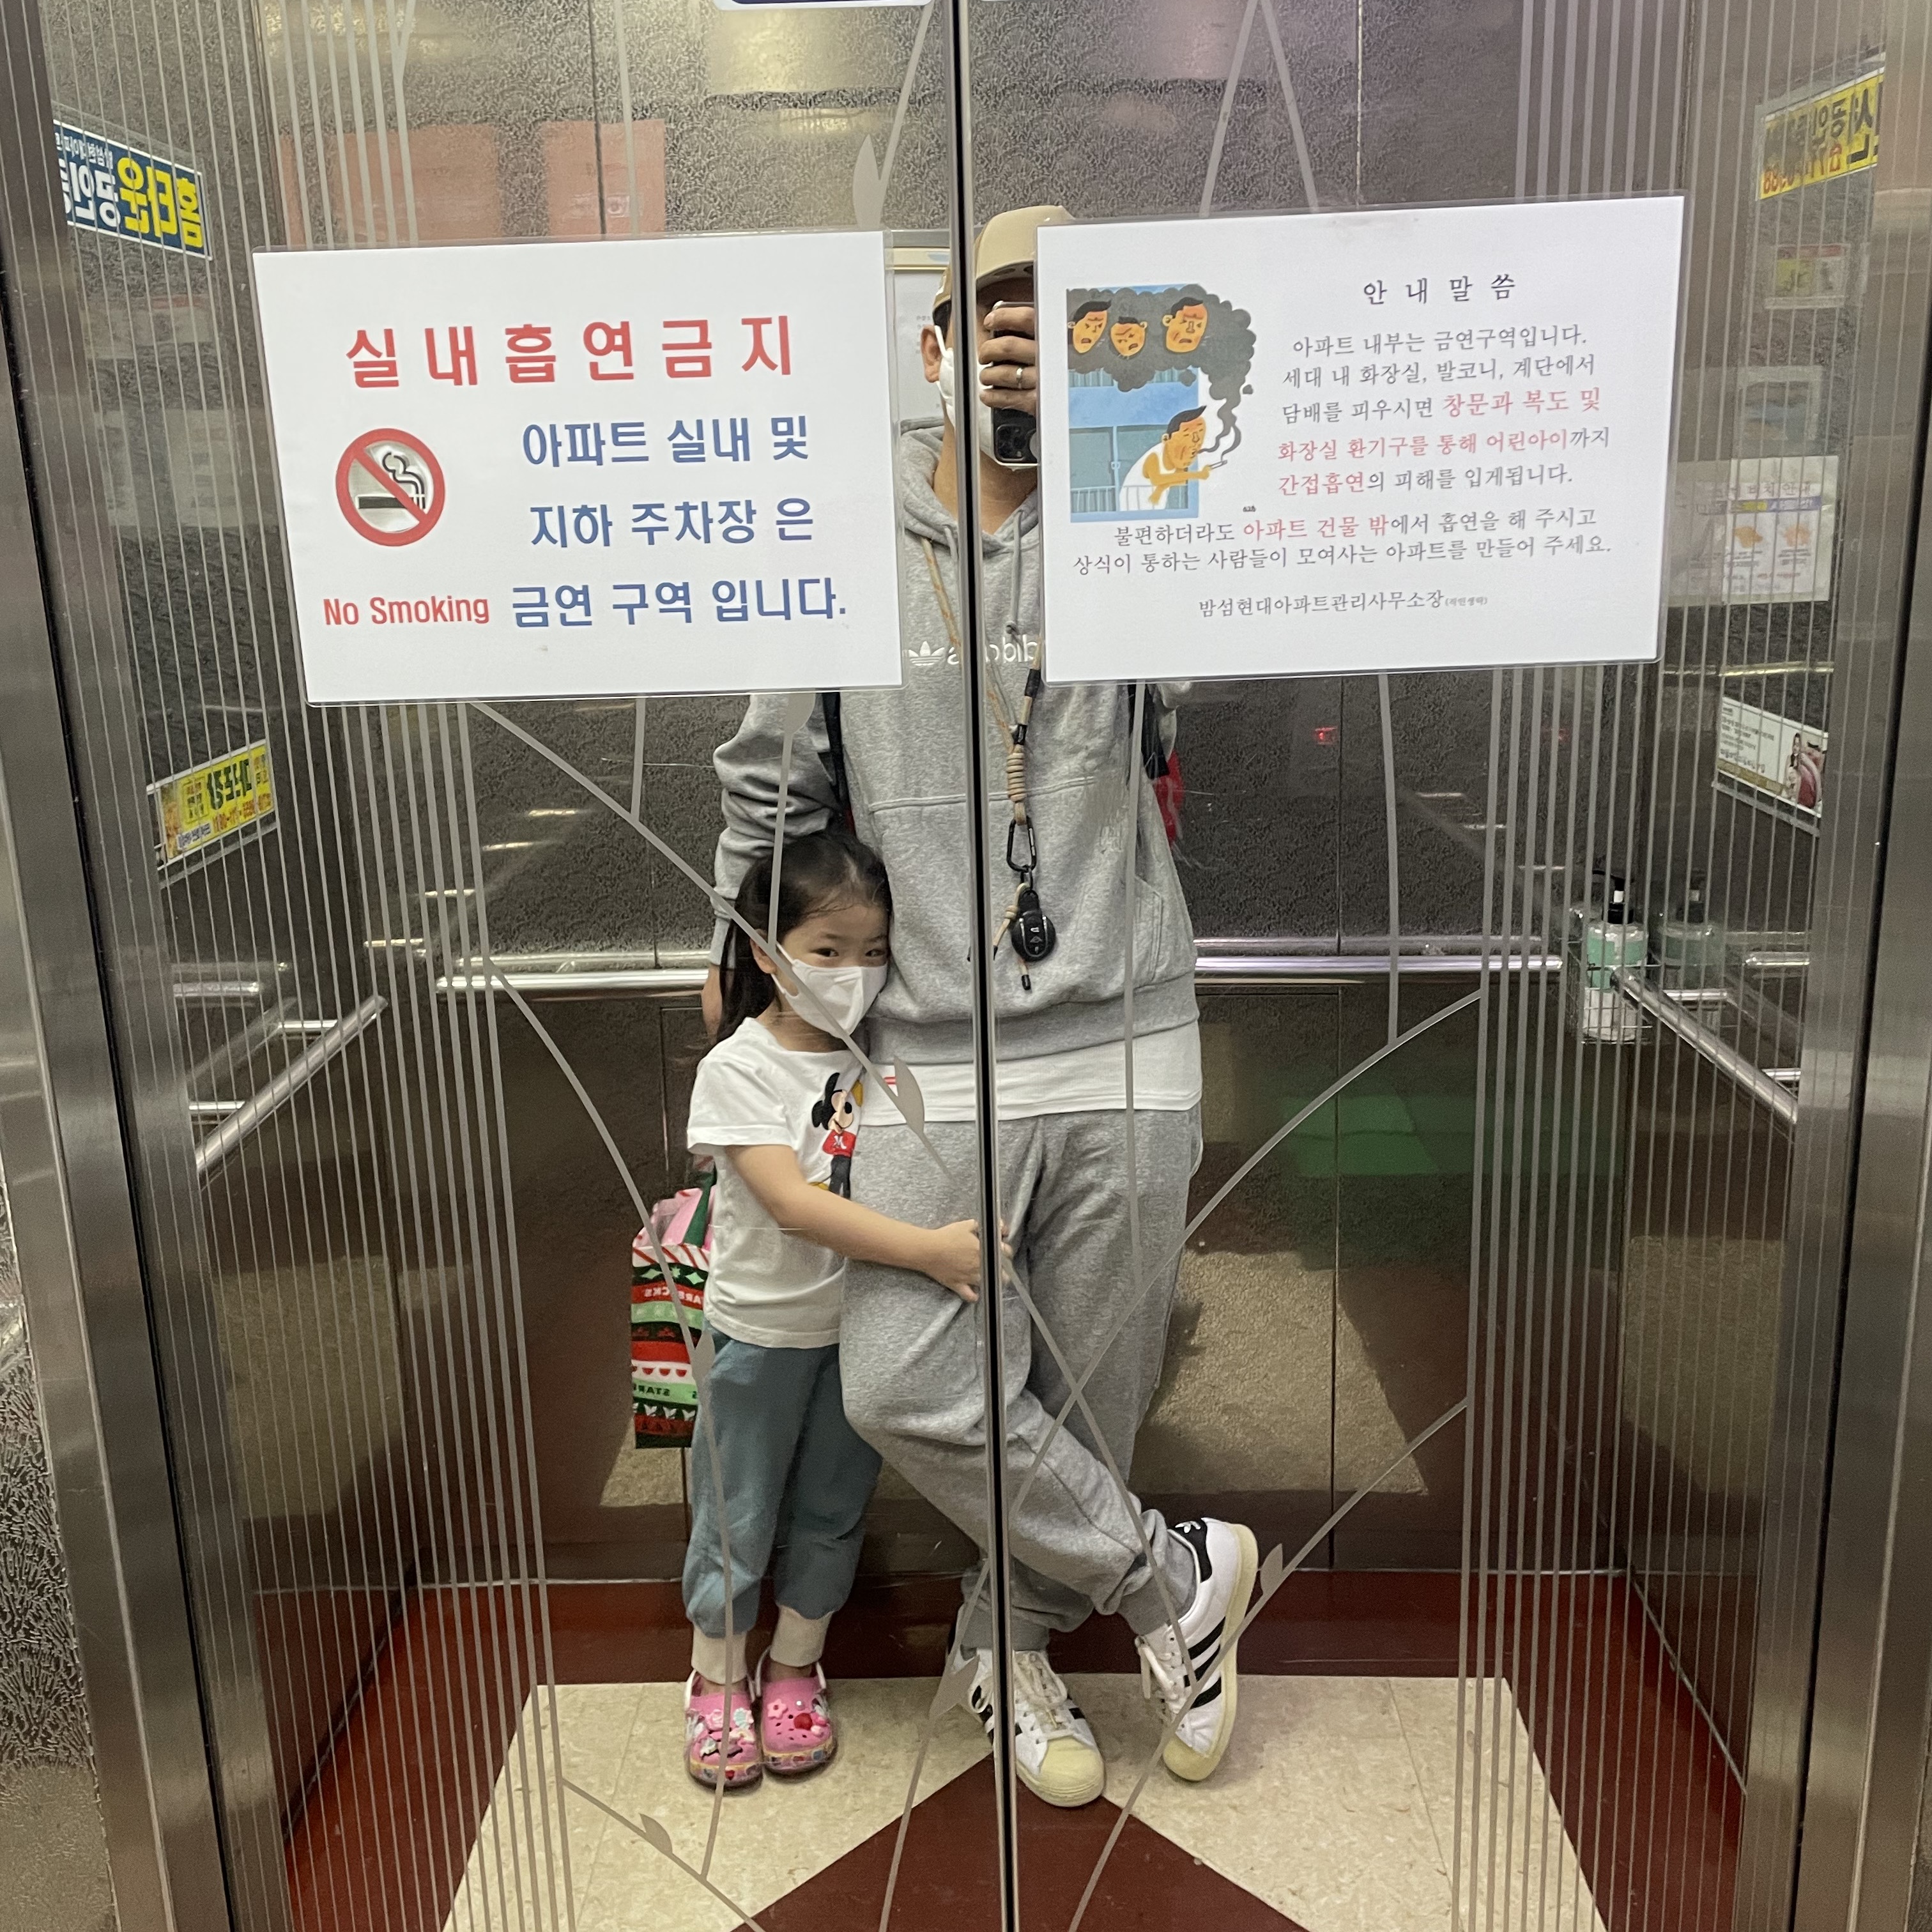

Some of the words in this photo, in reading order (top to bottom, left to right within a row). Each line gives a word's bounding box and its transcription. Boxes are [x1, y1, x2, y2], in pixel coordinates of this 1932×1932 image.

[1293, 336, 1354, 358] 아파트
[1363, 333, 1425, 355] 내부는
[1434, 324, 1586, 351] 금연구역입니다.
[1284, 367, 1321, 388] 세대
[1332, 365, 1349, 386] 내
[1360, 362, 1427, 385] 화장실,
[1437, 358, 1503, 381] 발코니,
[1514, 354, 1593, 378] 계단에서
[1283, 402, 1342, 424] 담배를
[1351, 397, 1432, 420] 피우시면
[1444, 392, 1513, 417] 창문과
[1523, 390, 1568, 413] 복도
[1581, 387, 1599, 411] 및
[523, 422, 649, 468] 아파트
[667, 418, 750, 463] 실내
[771, 415, 808, 461] 및
[1278, 440, 1337, 461] 화장실
[1347, 436, 1428, 458] 환기구를
[1438, 433, 1476, 455] 통해
[1487, 427, 1609, 452] 어린아이까지
[1279, 471, 1384, 496] 간접흡연의
[1395, 469, 1456, 491] 피해를
[1465, 463, 1572, 488] 입게됩니다.
[530, 504, 613, 548] 지하
[631, 500, 756, 546] 주차장
[776, 498, 813, 540] 은
[1114, 523, 1234, 546] 불편하더라도
[1244, 519, 1307, 541] 아파트
[1317, 517, 1359, 538] 건물
[1369, 514, 1428, 536] 밖에서
[1439, 511, 1499, 533] 흡연을
[1508, 510, 1526, 530] 해
[1536, 507, 1596, 528] 주시고
[1074, 554, 1130, 575] 상식이
[1141, 552, 1200, 572] 통하는
[1208, 548, 1286, 569] 사람들이
[1297, 544, 1377, 565] 모여사는
[1386, 540, 1467, 562] 아파트를
[1476, 537, 1534, 558] 만들어
[1544, 535, 1610, 555] 주세요.
[323, 599, 359, 625] No
[369, 595, 489, 624] Smoking
[512, 585, 592, 627] 금연
[613, 582, 692, 625] 구역
[712, 578, 846, 622] 입니다.
